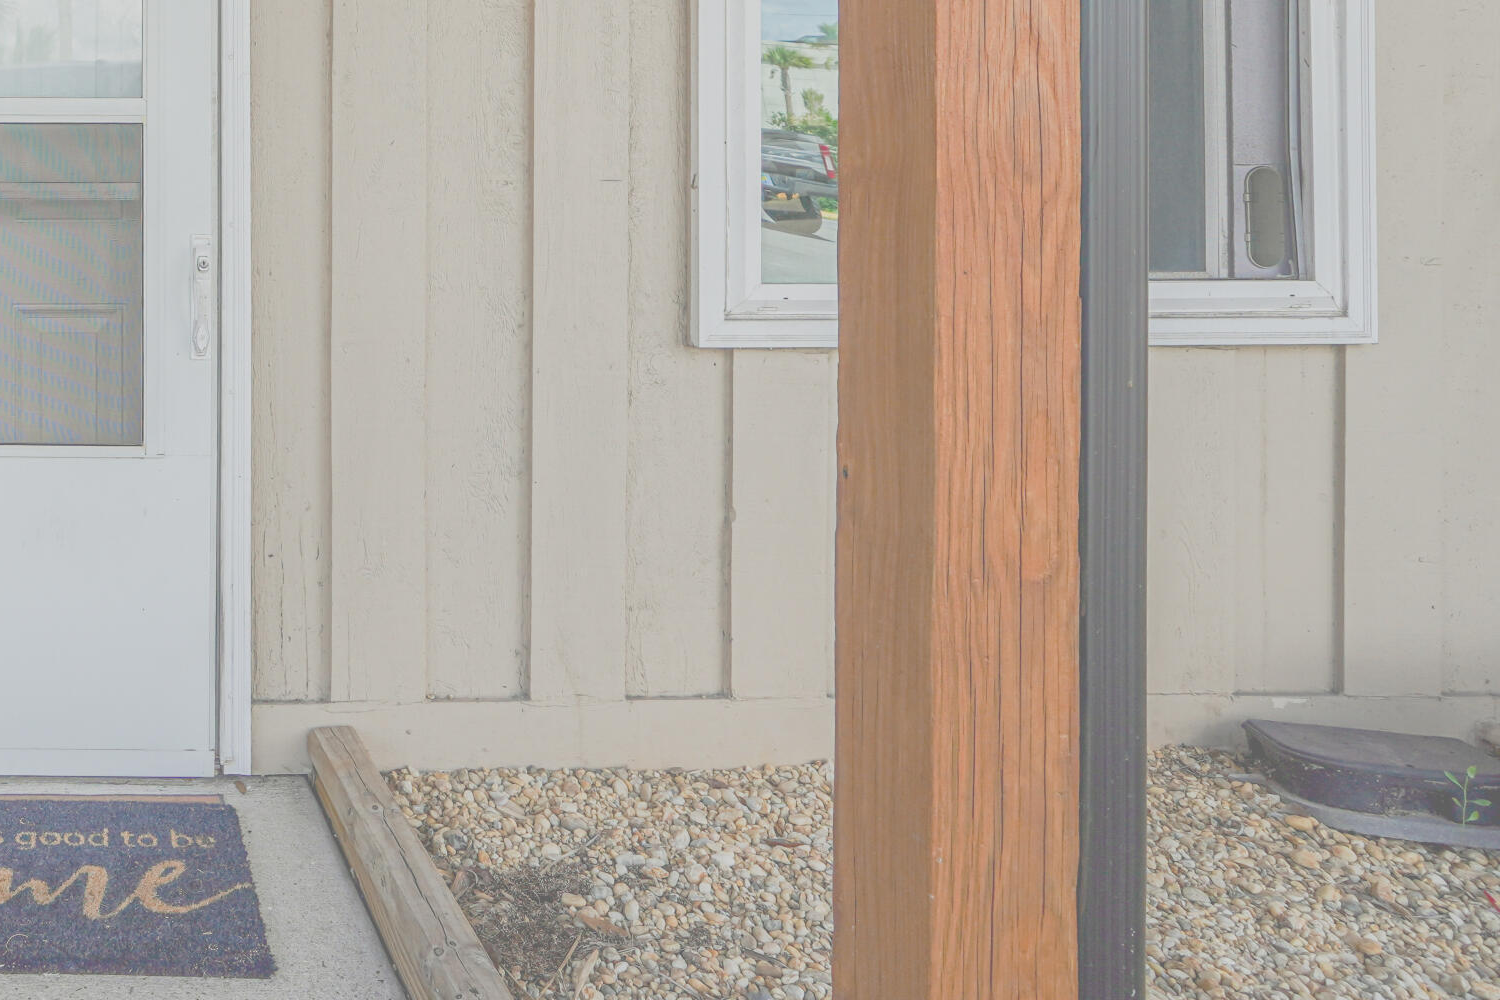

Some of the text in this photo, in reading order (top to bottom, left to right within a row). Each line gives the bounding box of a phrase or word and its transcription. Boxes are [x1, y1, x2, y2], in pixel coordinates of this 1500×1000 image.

[15, 826, 109, 851] good
[120, 829, 159, 848] to
[171, 827, 216, 849] be
